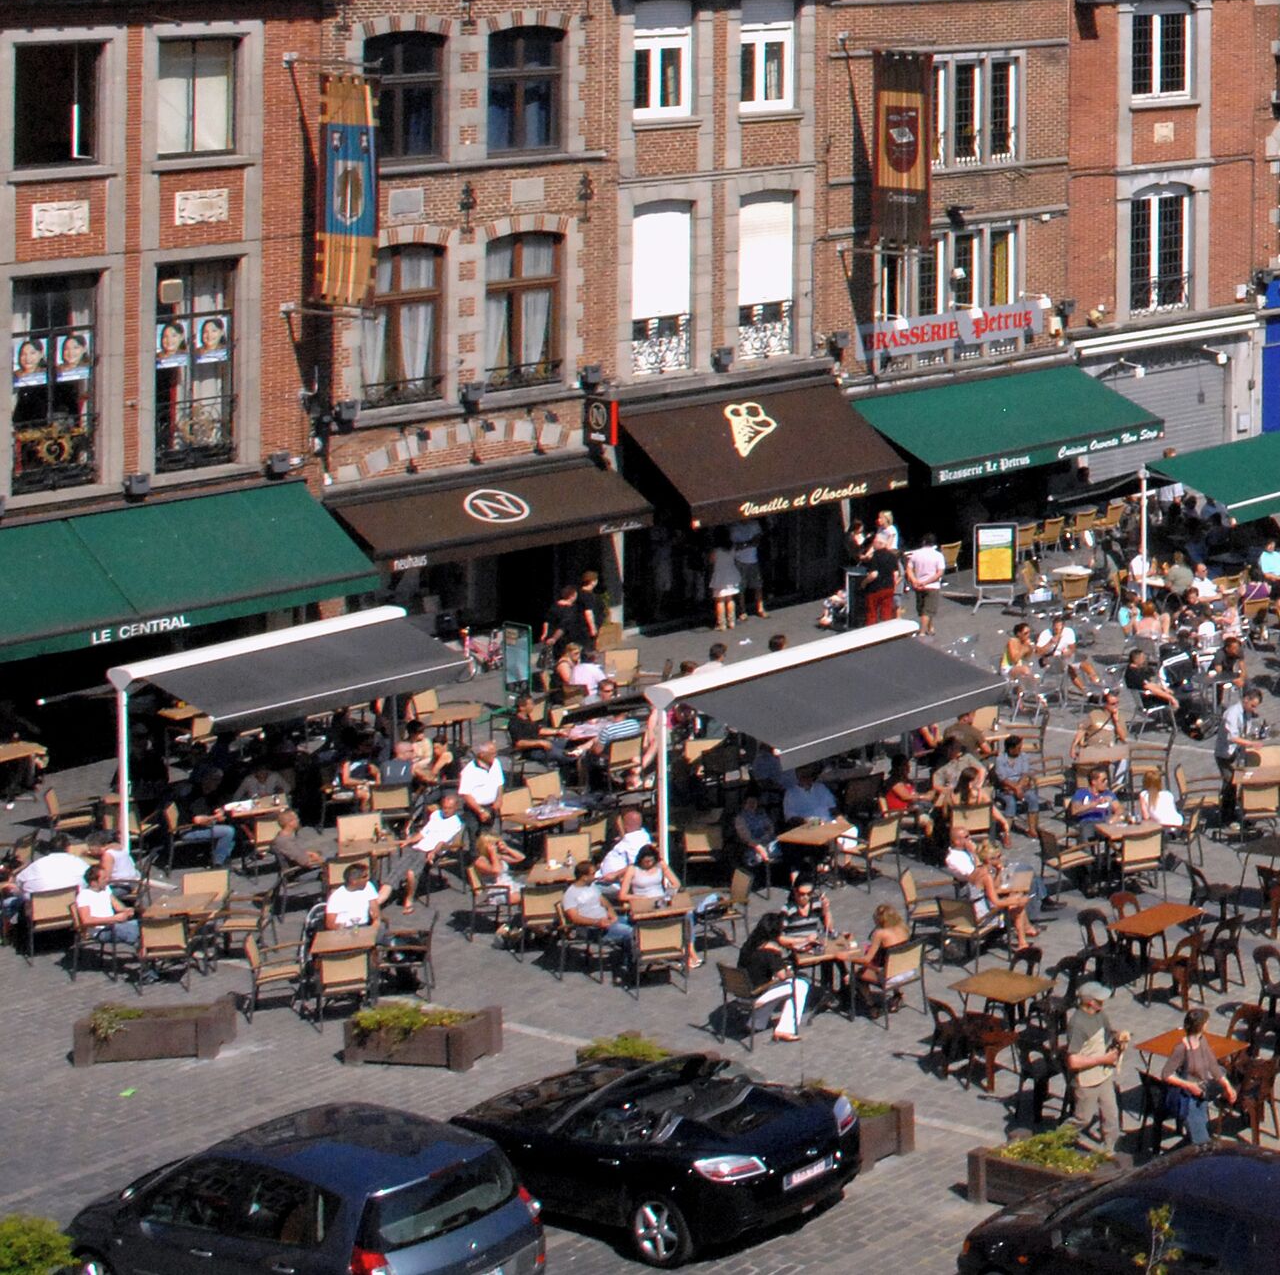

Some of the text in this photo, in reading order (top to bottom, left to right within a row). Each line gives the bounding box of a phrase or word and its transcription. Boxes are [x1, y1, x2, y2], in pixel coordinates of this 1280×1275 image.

[864, 310, 1034, 350] BRASSERIE Petrus
[939, 455, 1031, 483] Brasserie Le Petrus
[739, 498, 790, 518] Vanille
[793, 495, 807, 508] et
[808, 482, 868, 507] Chocolat
[392, 554, 428, 571] neuhaus
[91, 614, 191, 644] LE CENTRAL
